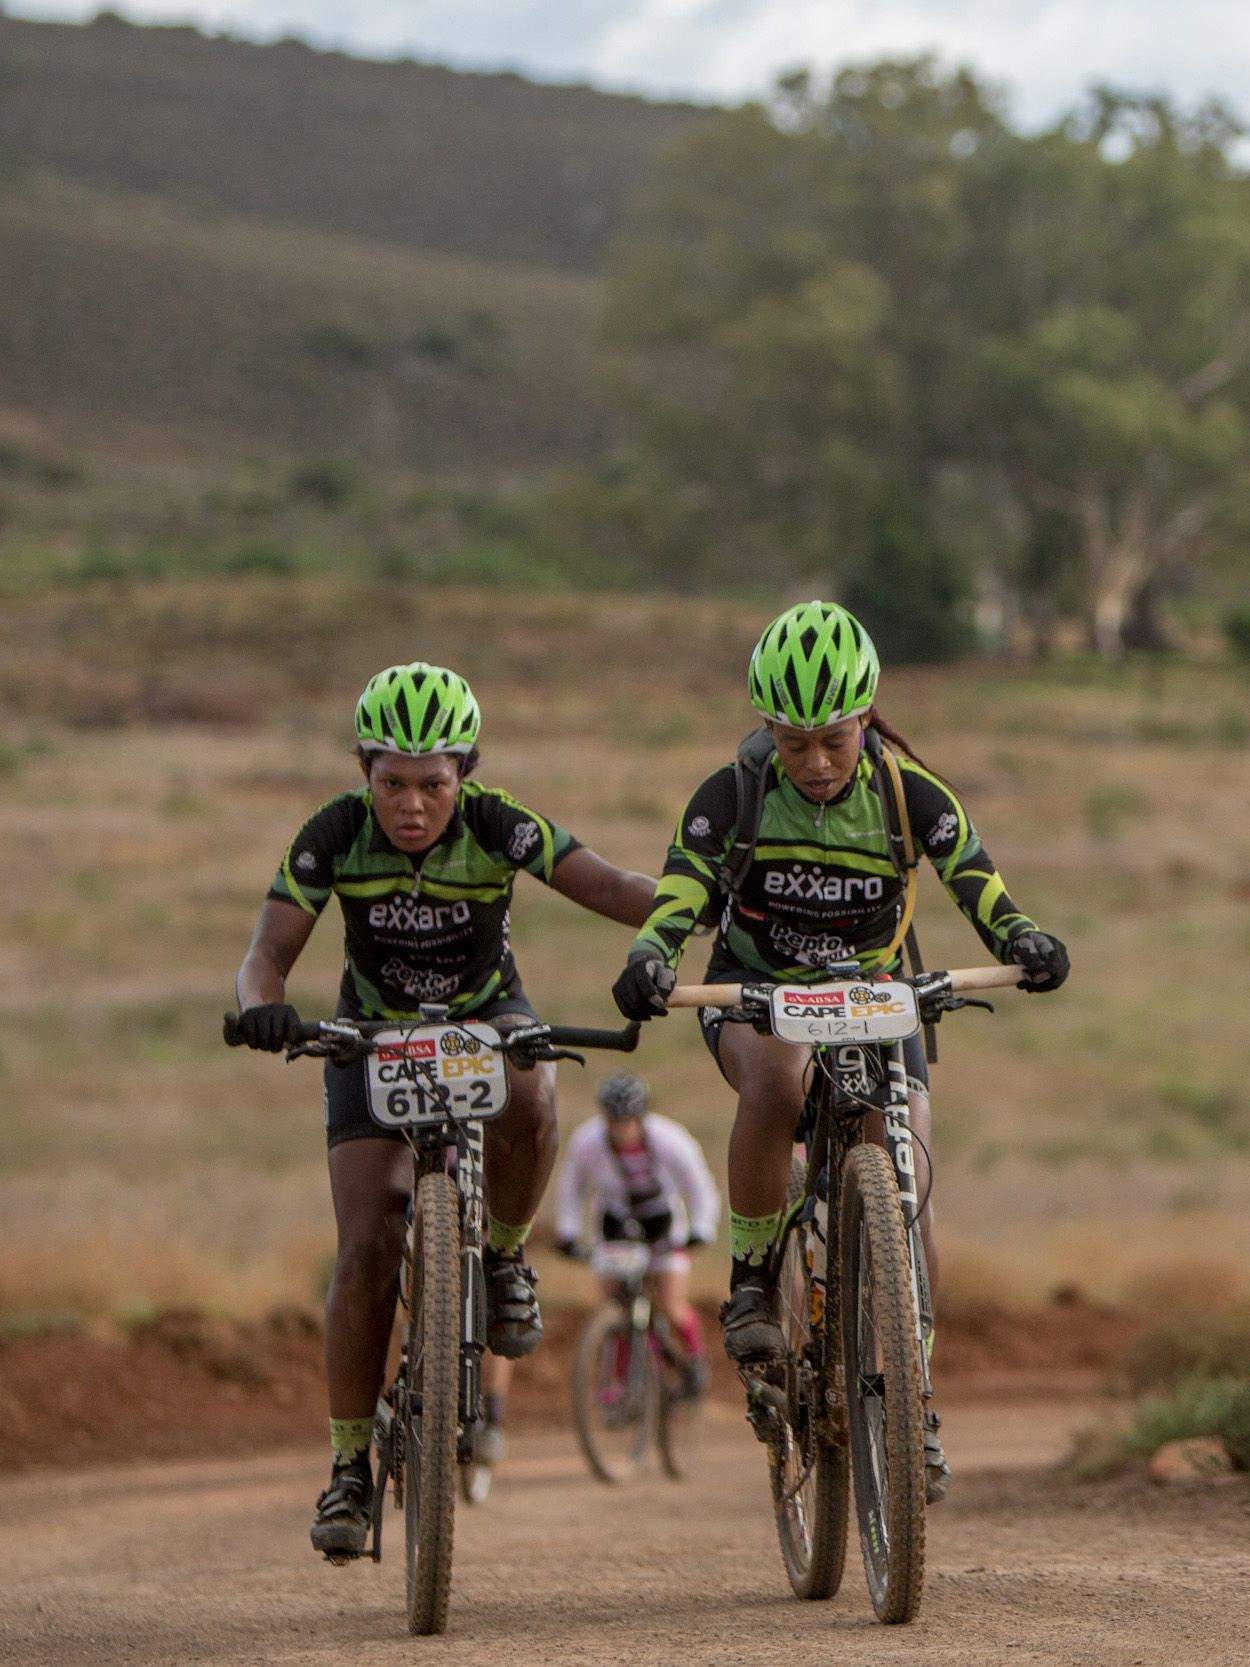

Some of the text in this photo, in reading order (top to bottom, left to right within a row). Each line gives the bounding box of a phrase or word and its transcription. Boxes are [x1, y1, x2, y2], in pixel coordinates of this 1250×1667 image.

[763, 864, 884, 902] exxaro
[368, 896, 471, 931] exxaro
[783, 1001, 907, 1019] CAPE EPIC
[808, 1020, 869, 1036] 612-1
[377, 1055, 496, 1083] CAPE EPIC
[386, 1080, 493, 1117] 612-2
